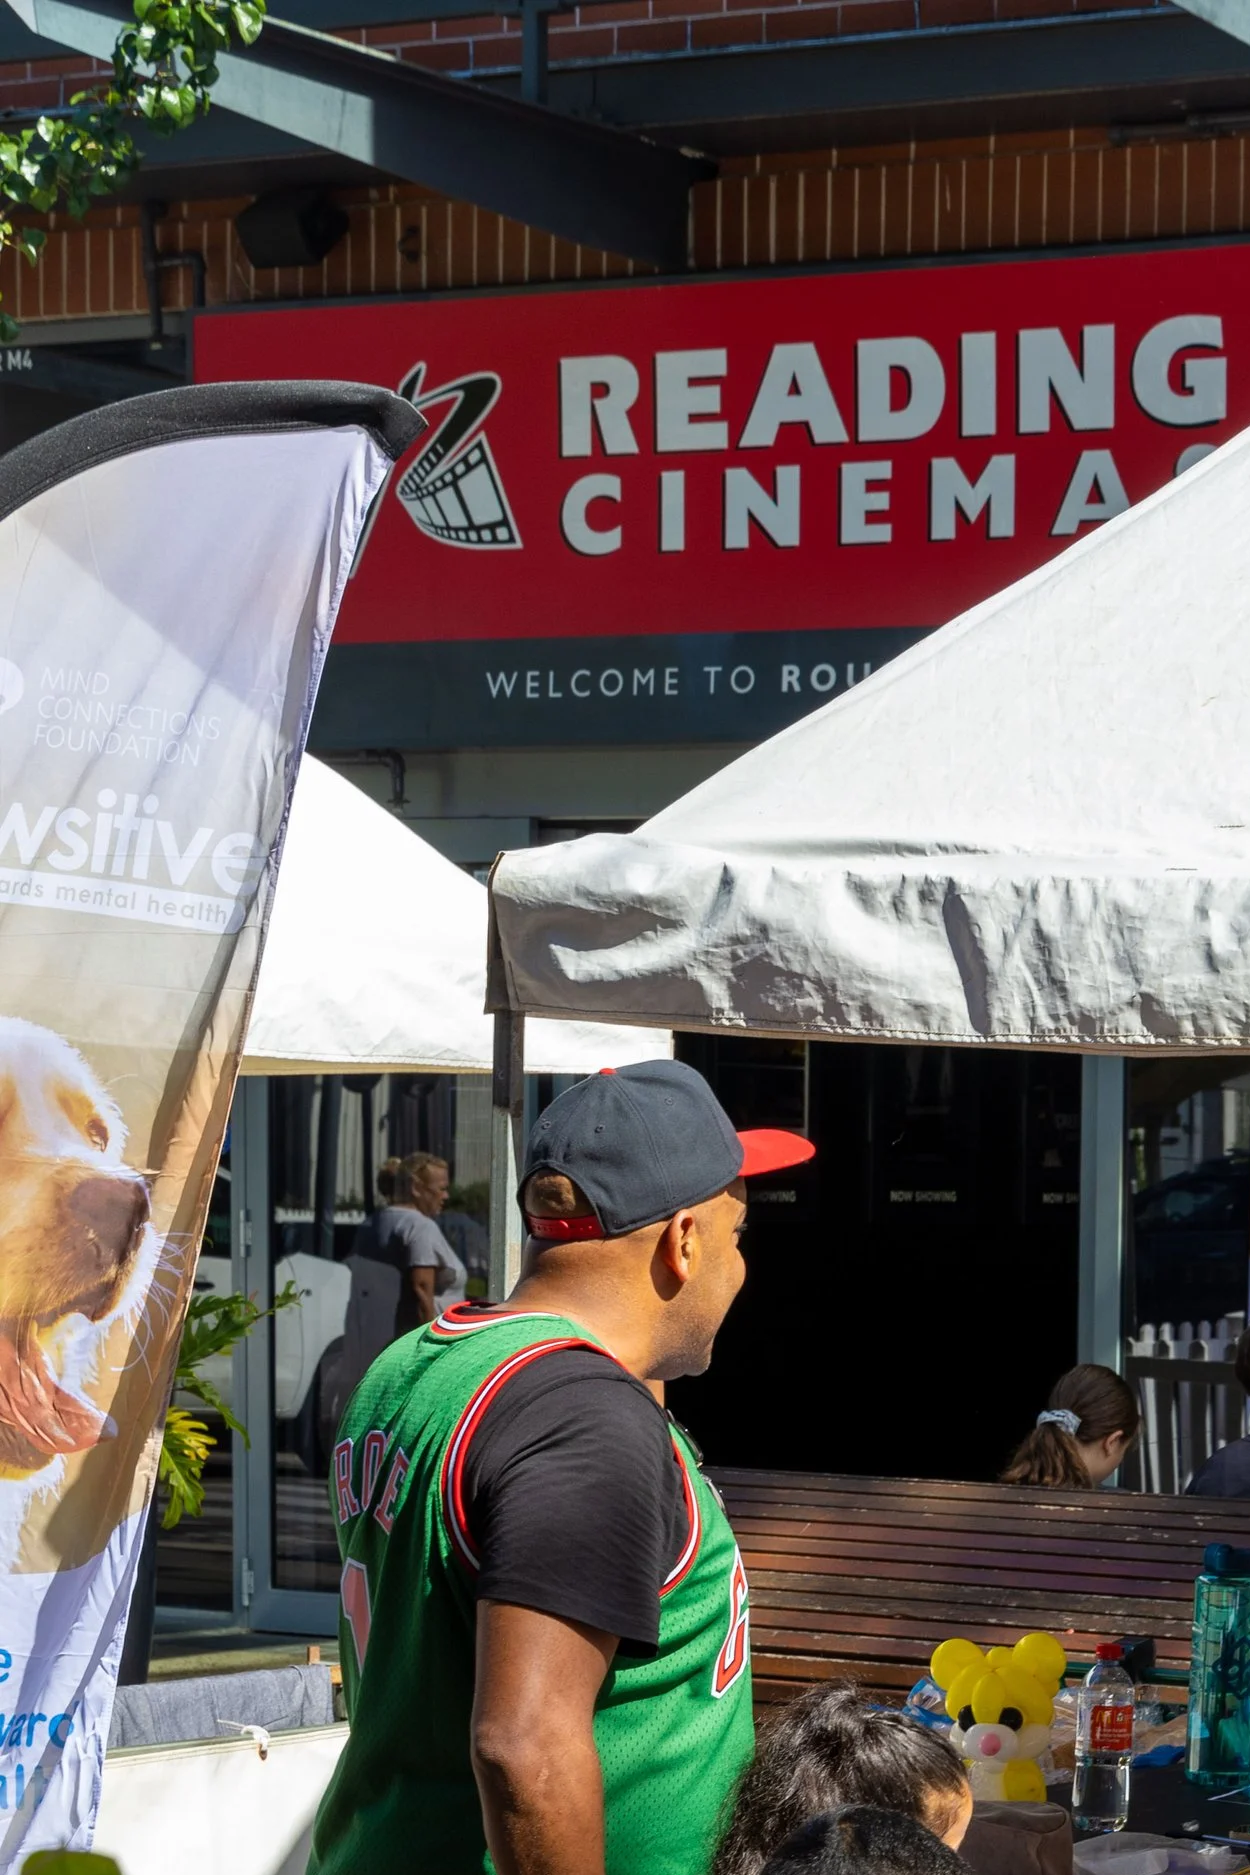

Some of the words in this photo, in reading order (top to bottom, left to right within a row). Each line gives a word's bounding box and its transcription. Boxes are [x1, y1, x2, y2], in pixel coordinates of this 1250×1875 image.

[559, 313, 1227, 458] READING
[40, 667, 110, 695] MIND
[486, 667, 680, 699] WELCOME
[703, 665, 756, 694] TO
[37, 696, 221, 740] CONNECTIONS
[34, 724, 200, 767] FOUNDATION
[56, 884, 136, 910] mental
[148, 894, 228, 925] health
[890, 1190, 912, 1203] NOW
[915, 1190, 957, 1203] SHOWING
[1042, 1192, 1065, 1204] NOW
